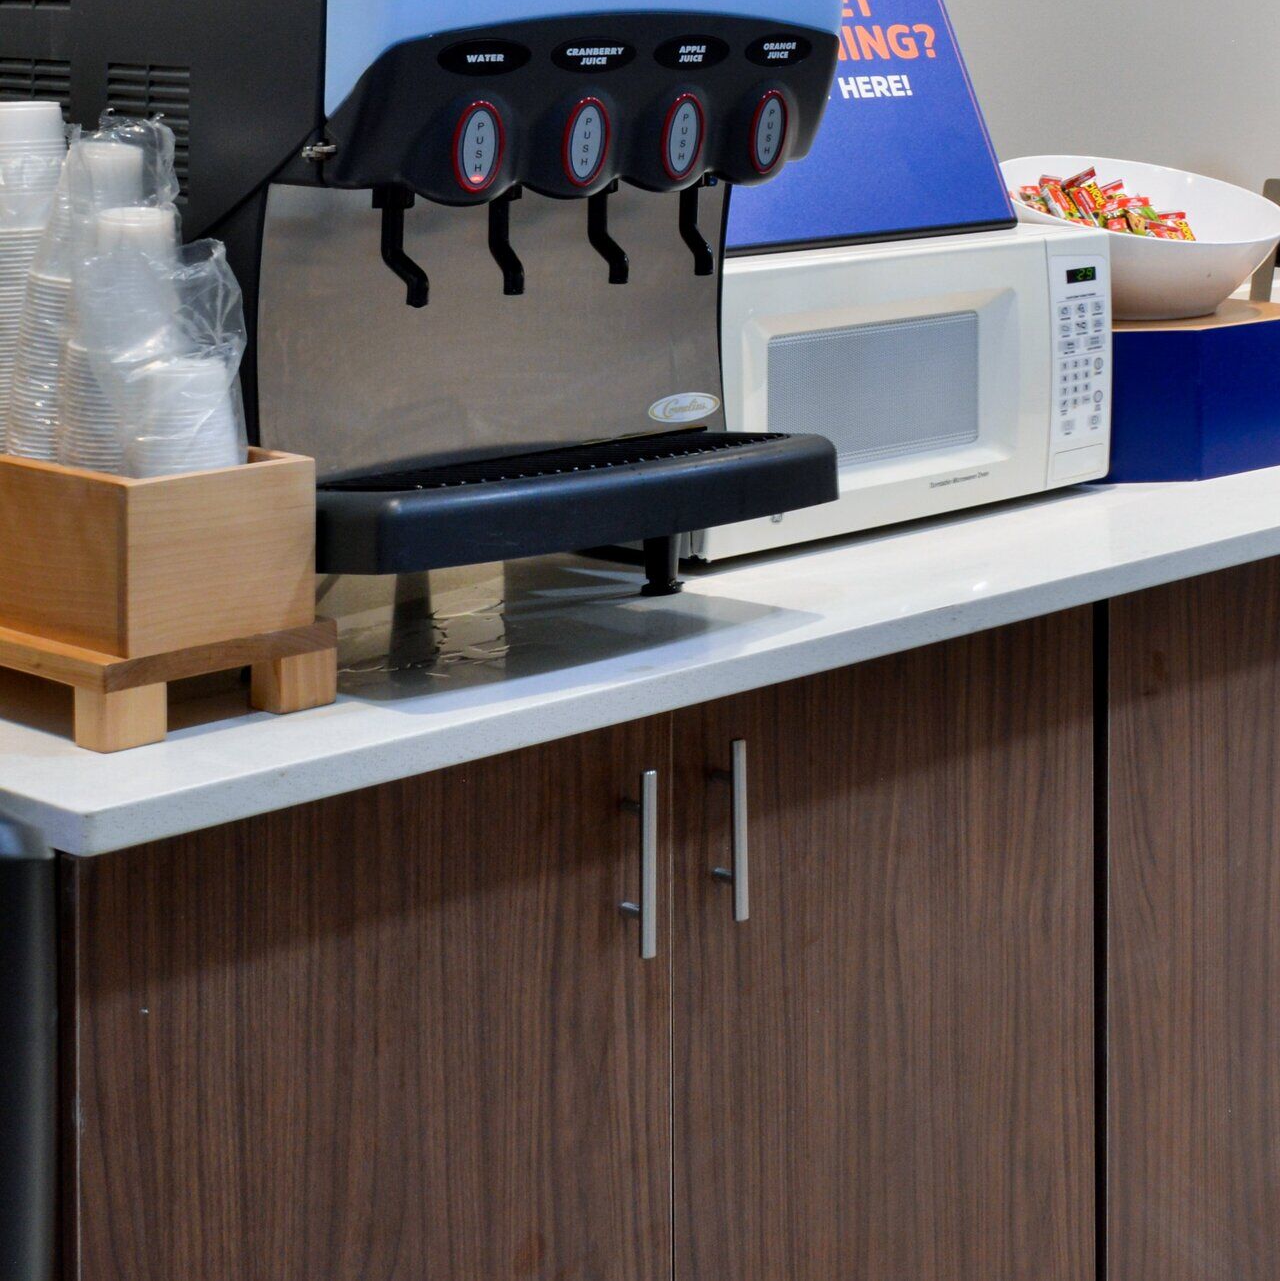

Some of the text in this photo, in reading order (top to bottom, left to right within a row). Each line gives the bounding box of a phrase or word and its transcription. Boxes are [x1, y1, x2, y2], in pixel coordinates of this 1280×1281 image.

[679, 45, 706, 54] APPLE
[763, 42, 796, 51] ORANGE
[566, 47, 625, 56] CRANBERRY
[767, 51, 789, 60] JUICE
[466, 54, 504, 63] WATER
[580, 57, 607, 65] JUICE
[679, 55, 703, 63] JUICE
[838, 75, 913, 99] HERE!
[678, 113, 689, 160] PUSH
[764, 109, 775, 155] PUSH
[581, 117, 592, 166] PUSH
[474, 122, 485, 172] PUSH
